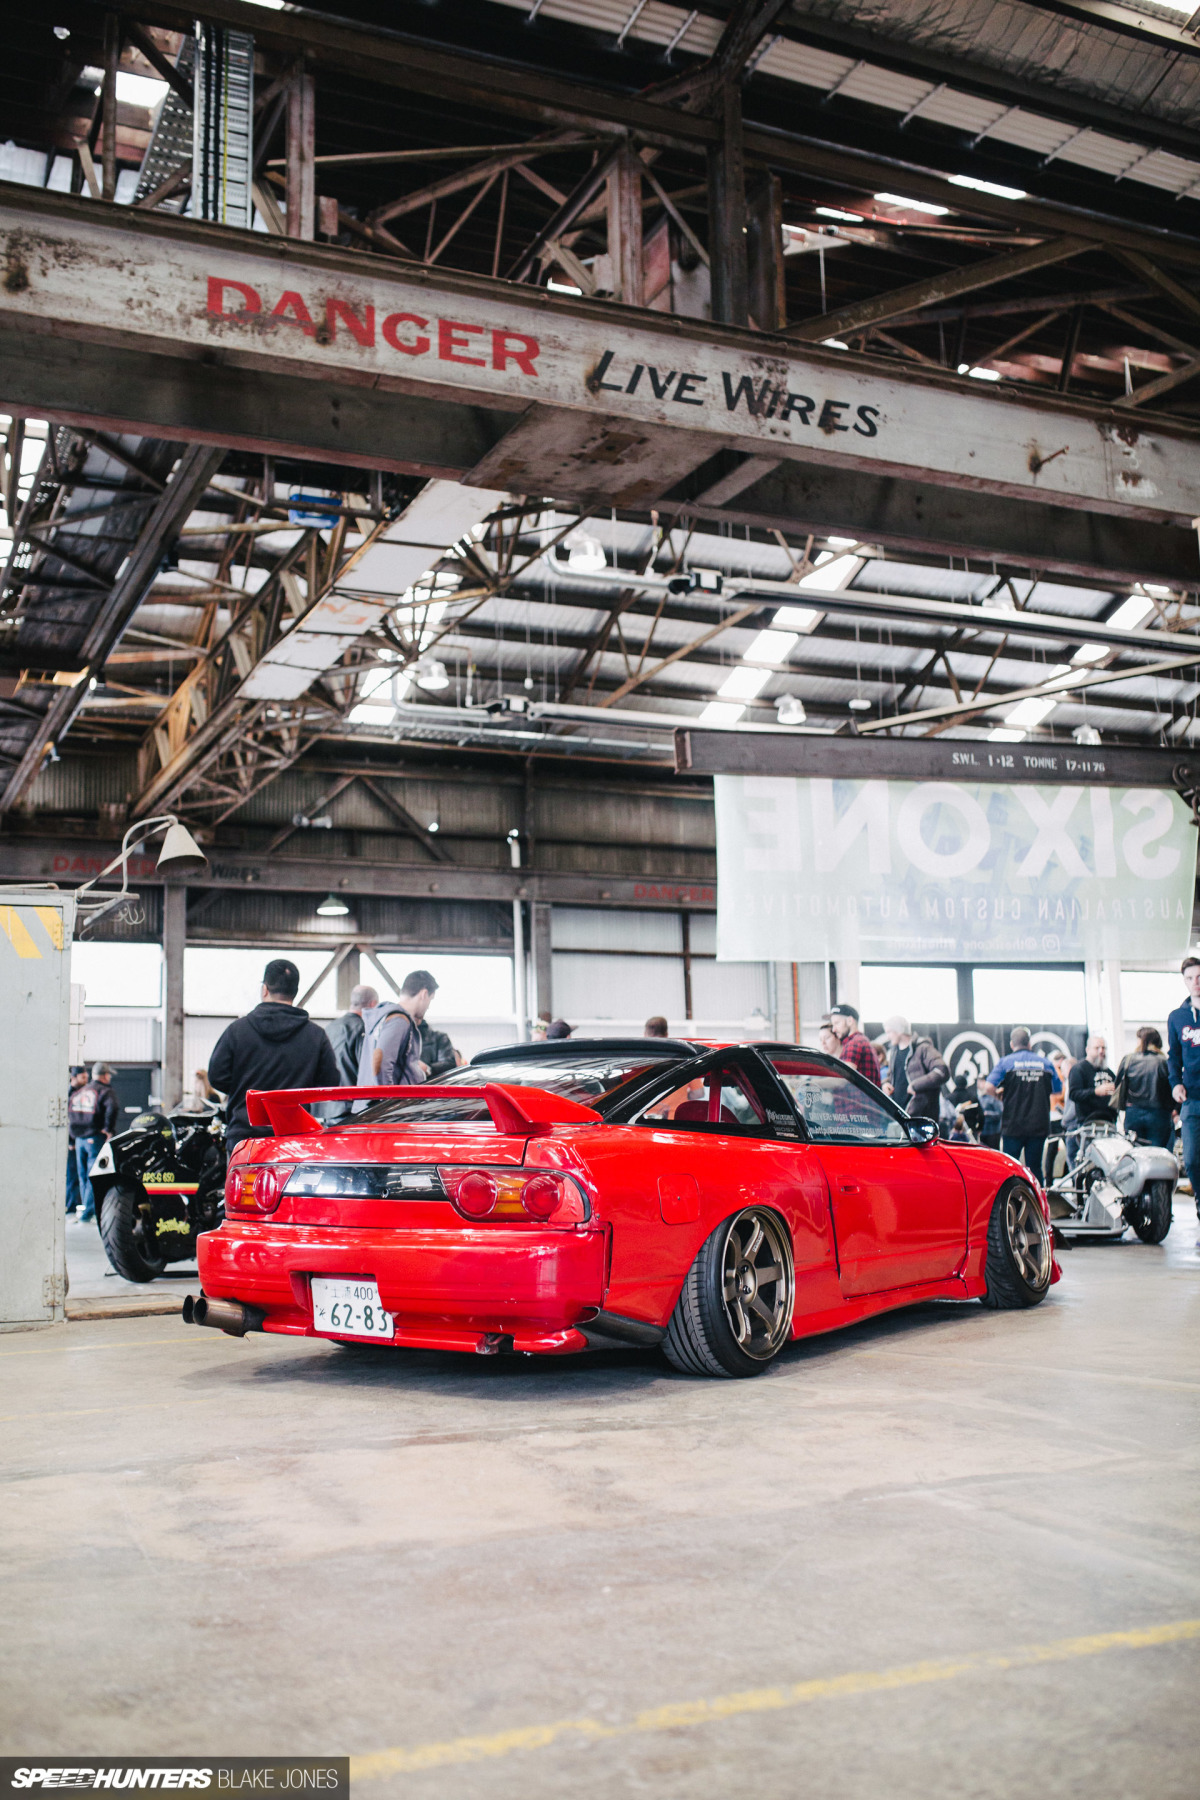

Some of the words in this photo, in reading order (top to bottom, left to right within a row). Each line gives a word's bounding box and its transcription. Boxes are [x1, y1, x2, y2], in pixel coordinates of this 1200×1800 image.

[206, 276, 541, 377] DANGER
[592, 350, 707, 406] LIVE
[721, 371, 880, 437] WIRES
[1022, 755, 1058, 770] TONNE
[633, 883, 714, 902] DANGER
[954, 1048, 990, 1085] 61
[353, 1286, 374, 1301] 400
[331, 1303, 388, 1332] 62-83
